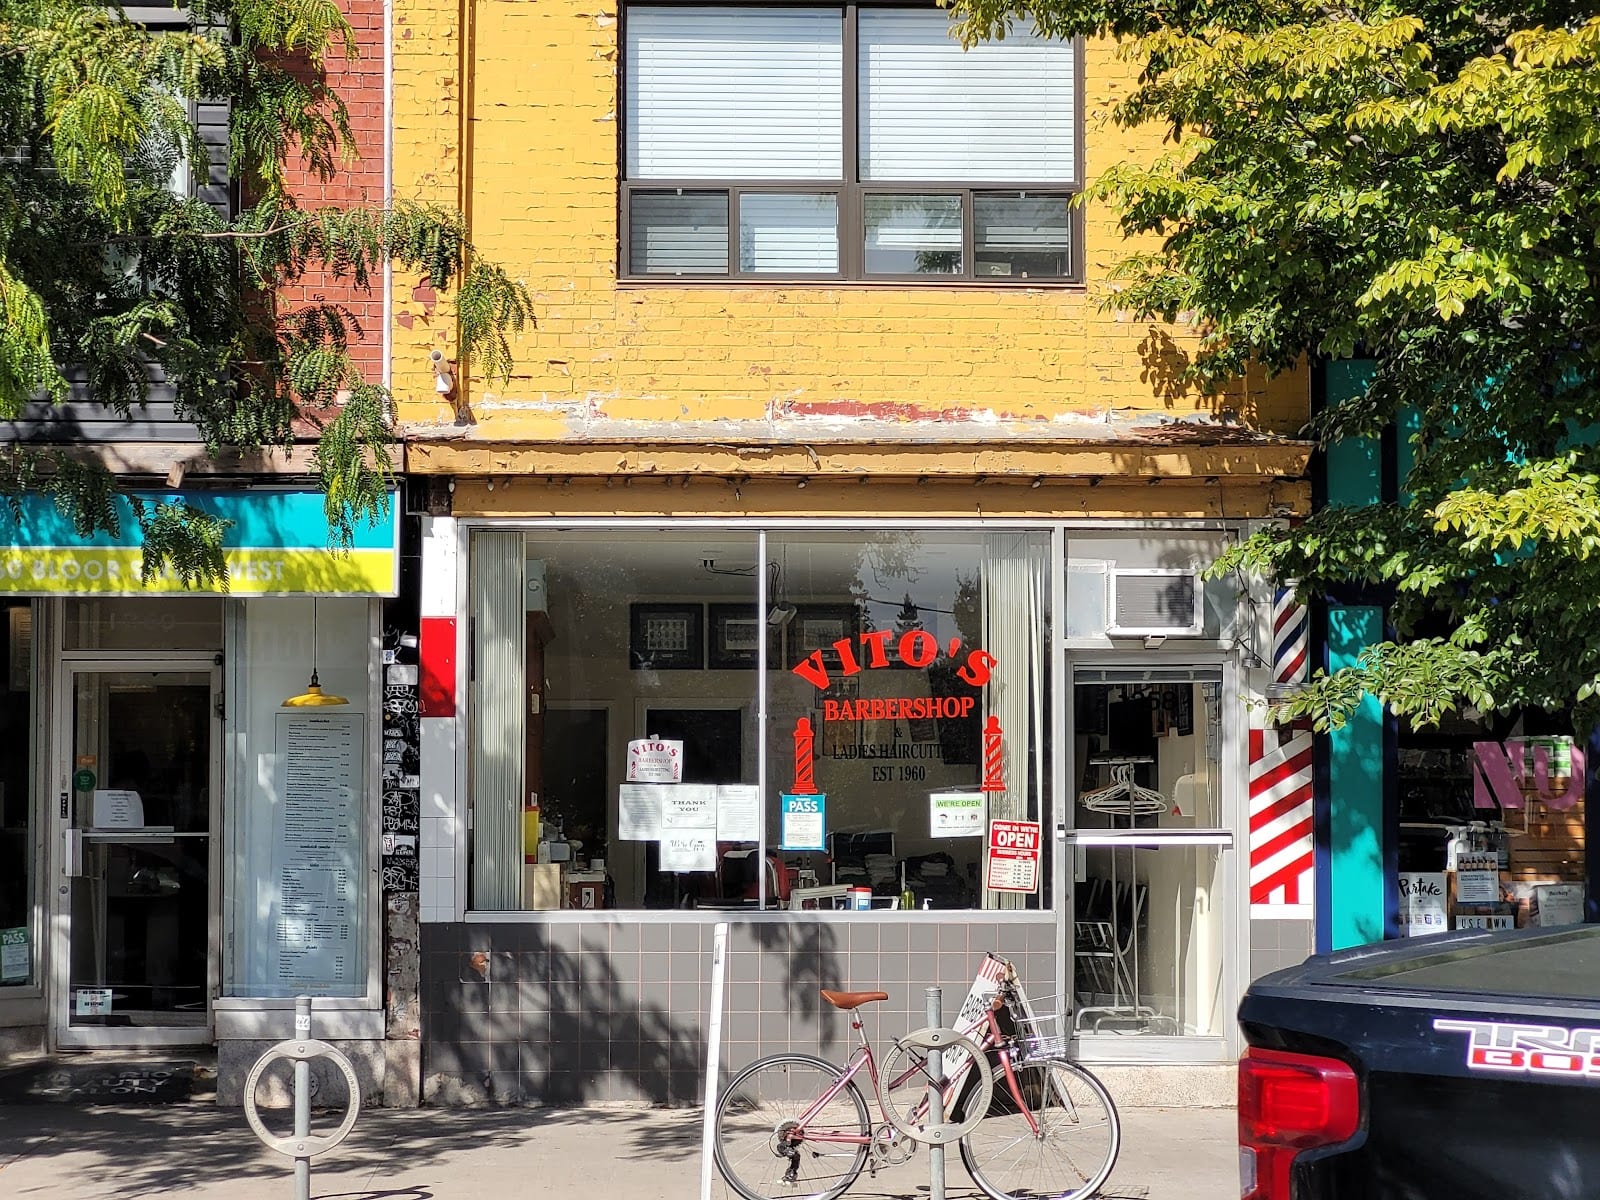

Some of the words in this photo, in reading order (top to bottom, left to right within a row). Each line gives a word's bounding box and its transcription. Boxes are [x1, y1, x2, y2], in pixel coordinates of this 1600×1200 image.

[33, 560, 120, 579] BLOOR
[229, 560, 285, 580] WEST
[792, 629, 998, 690] VITO'S
[824, 697, 975, 721] BARBERSHOP
[894, 728, 903, 738] &
[632, 743, 678, 757] VITO'S
[833, 744, 876, 760] LADIES
[872, 766, 895, 782] EST
[899, 766, 926, 782] 1960
[789, 801, 819, 812] PASS
[997, 831, 1034, 848] OPEN
[1398, 877, 1443, 898] Partake
[1461, 918, 1481, 928] USE
[1486, 918, 1507, 929] OWN
[2, 932, 25, 945] PASS
[1468, 1048, 1600, 1077] BO
